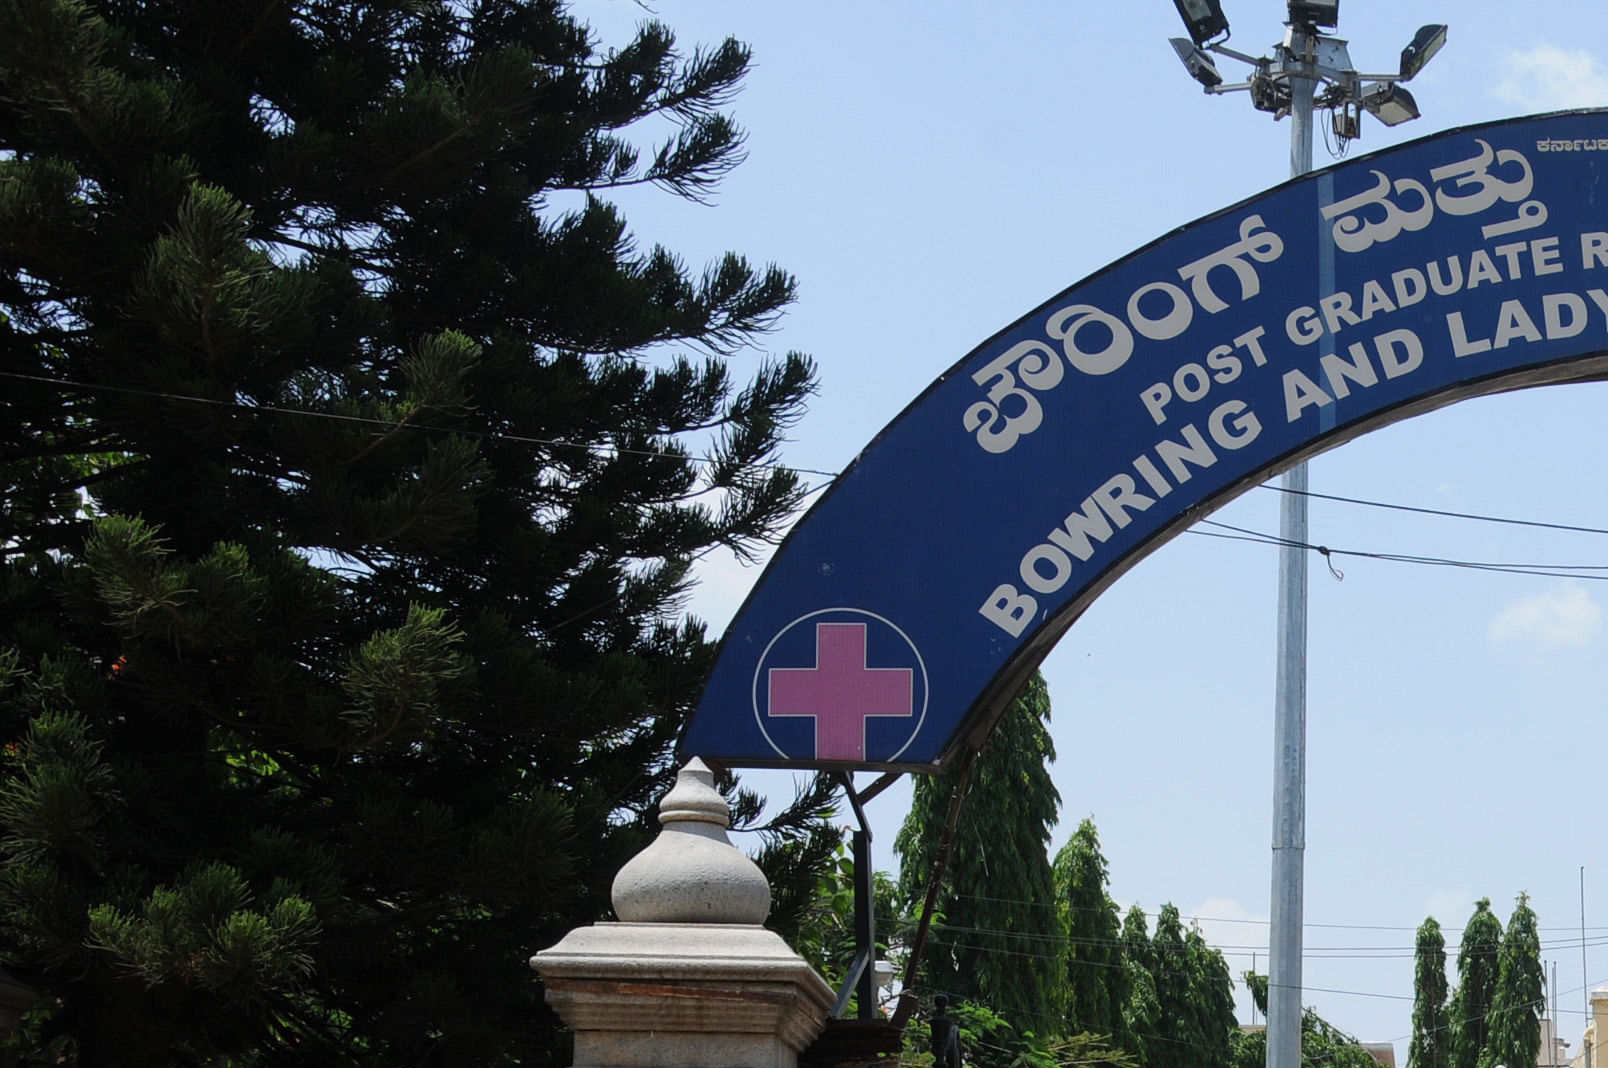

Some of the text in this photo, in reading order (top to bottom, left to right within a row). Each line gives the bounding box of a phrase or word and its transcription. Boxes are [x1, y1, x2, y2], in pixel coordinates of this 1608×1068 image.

[1321, 139, 1547, 252] ಮತ್ತು
[1140, 326, 1266, 424] POST
[1286, 237, 1563, 345] GRADUATE
[978, 402, 1262, 638] BOWRING
[1283, 330, 1423, 422] AND
